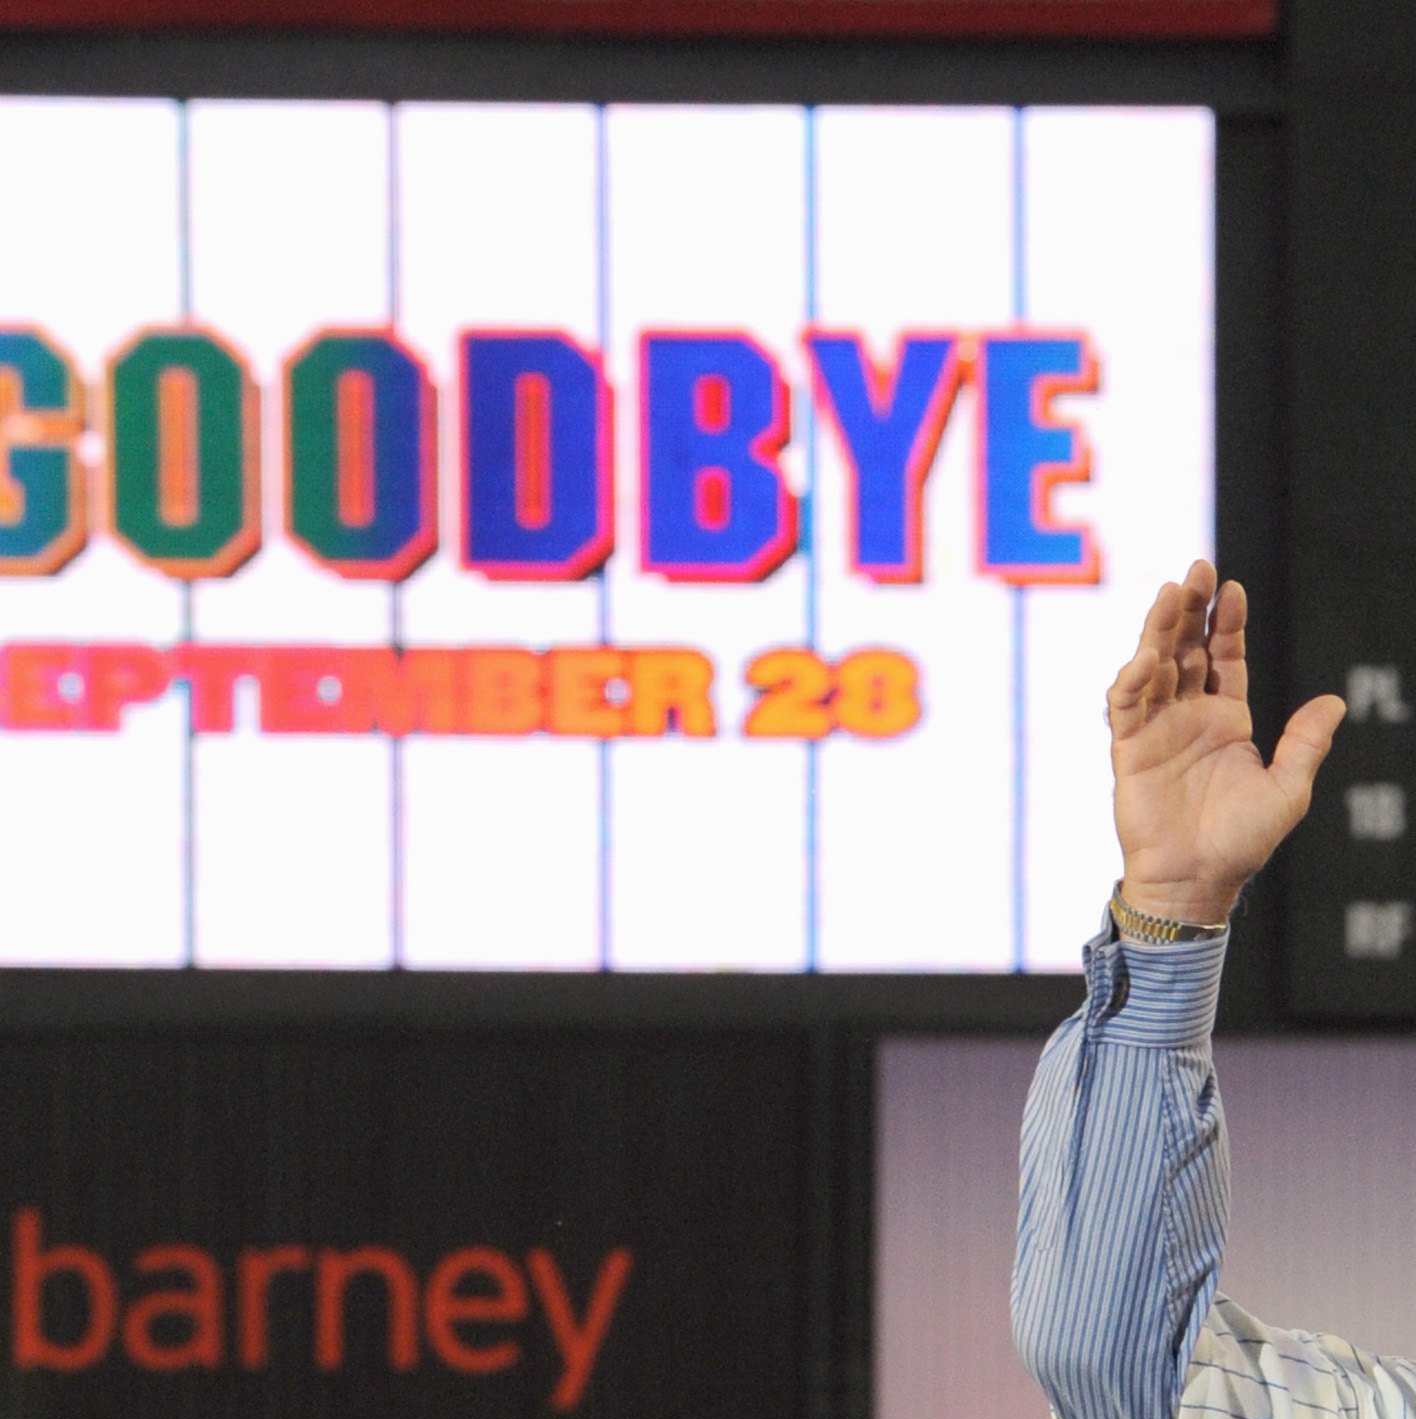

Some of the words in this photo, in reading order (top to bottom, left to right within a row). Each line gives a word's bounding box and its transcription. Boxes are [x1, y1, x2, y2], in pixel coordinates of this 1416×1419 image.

[0, 323, 1104, 584] GOODBYE
[742, 646, 921, 740] 28
[1346, 665, 1408, 723] PL
[1345, 901, 1411, 958] RF
[12, 1206, 633, 1411] barney
